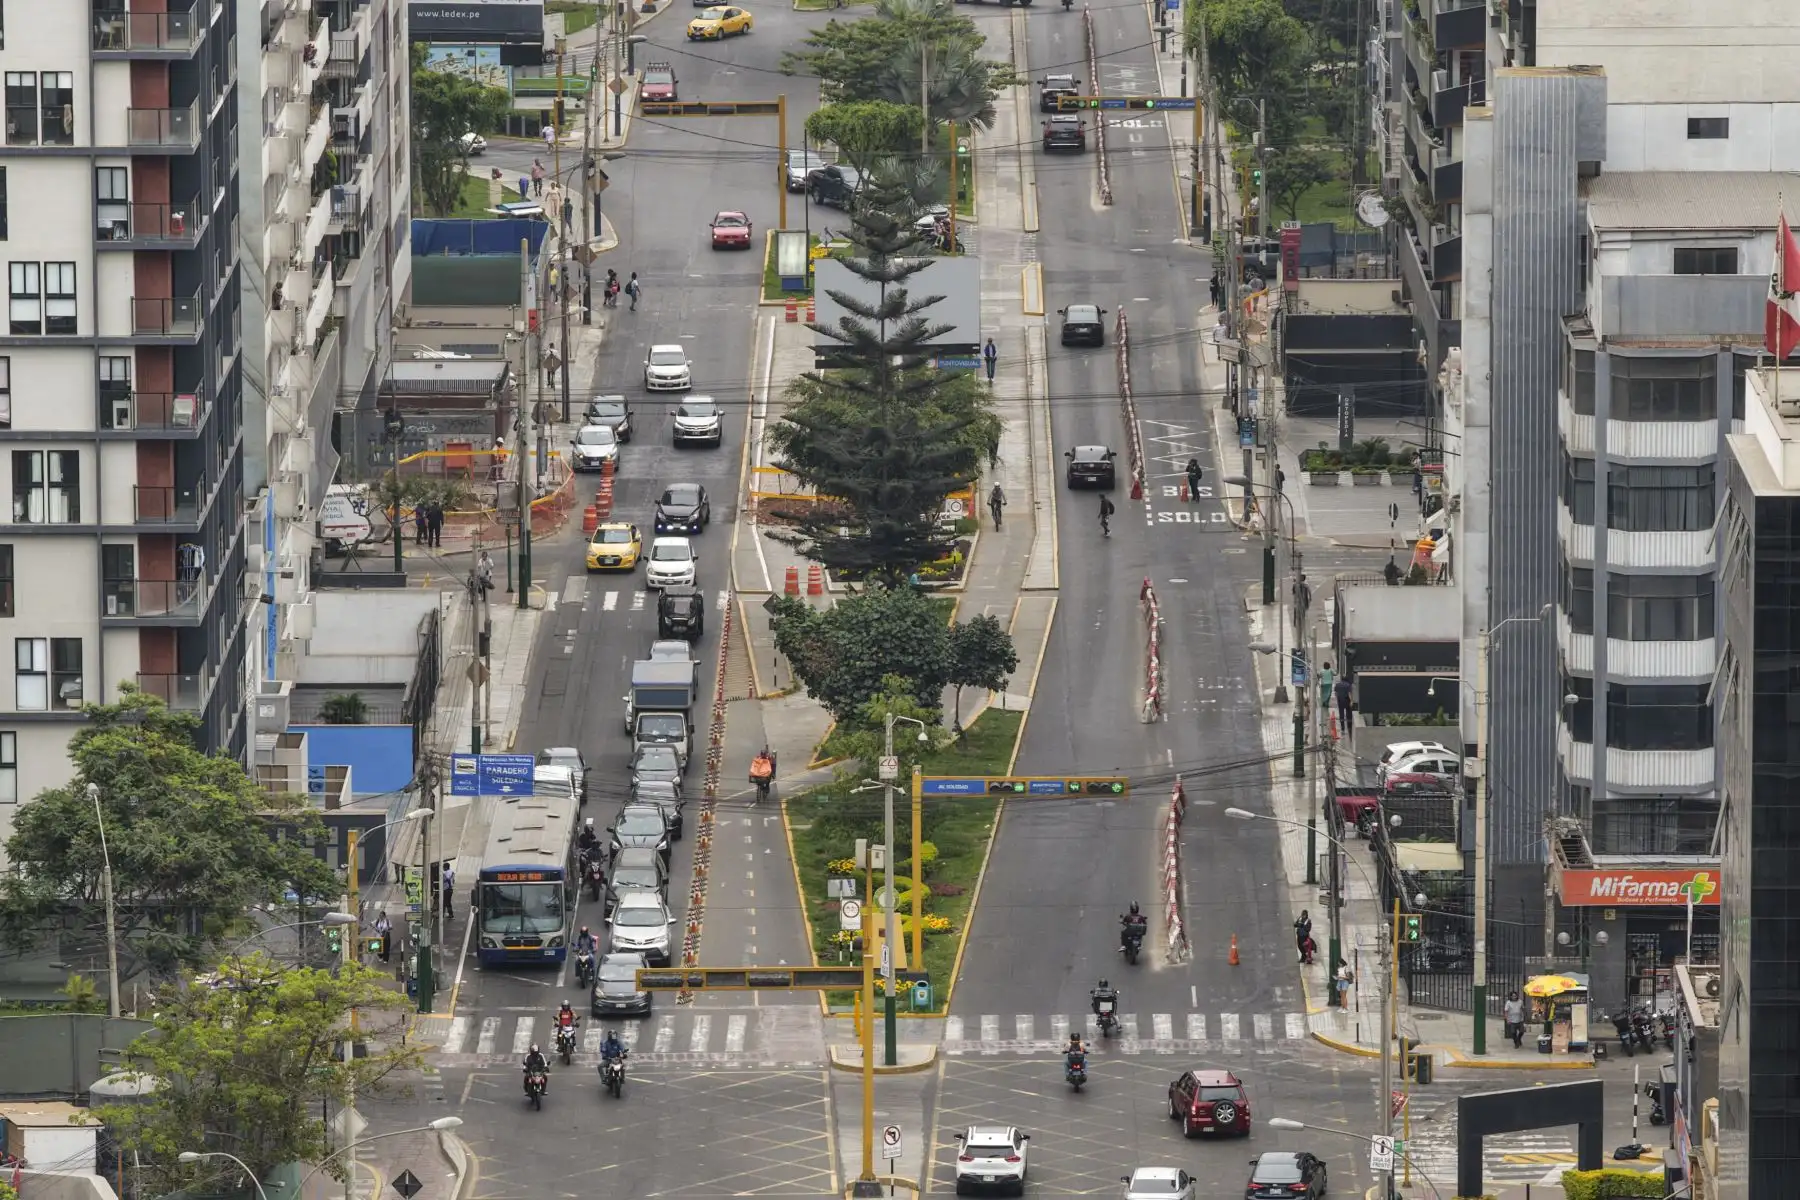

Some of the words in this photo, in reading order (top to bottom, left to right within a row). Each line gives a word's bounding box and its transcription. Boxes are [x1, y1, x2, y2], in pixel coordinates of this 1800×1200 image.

[416, 10, 480, 19] www.ledex.pe
[1157, 511, 1227, 523] SOLO
[486, 766, 528, 775] PARADERO
[1590, 875, 1680, 897] Mifarma
